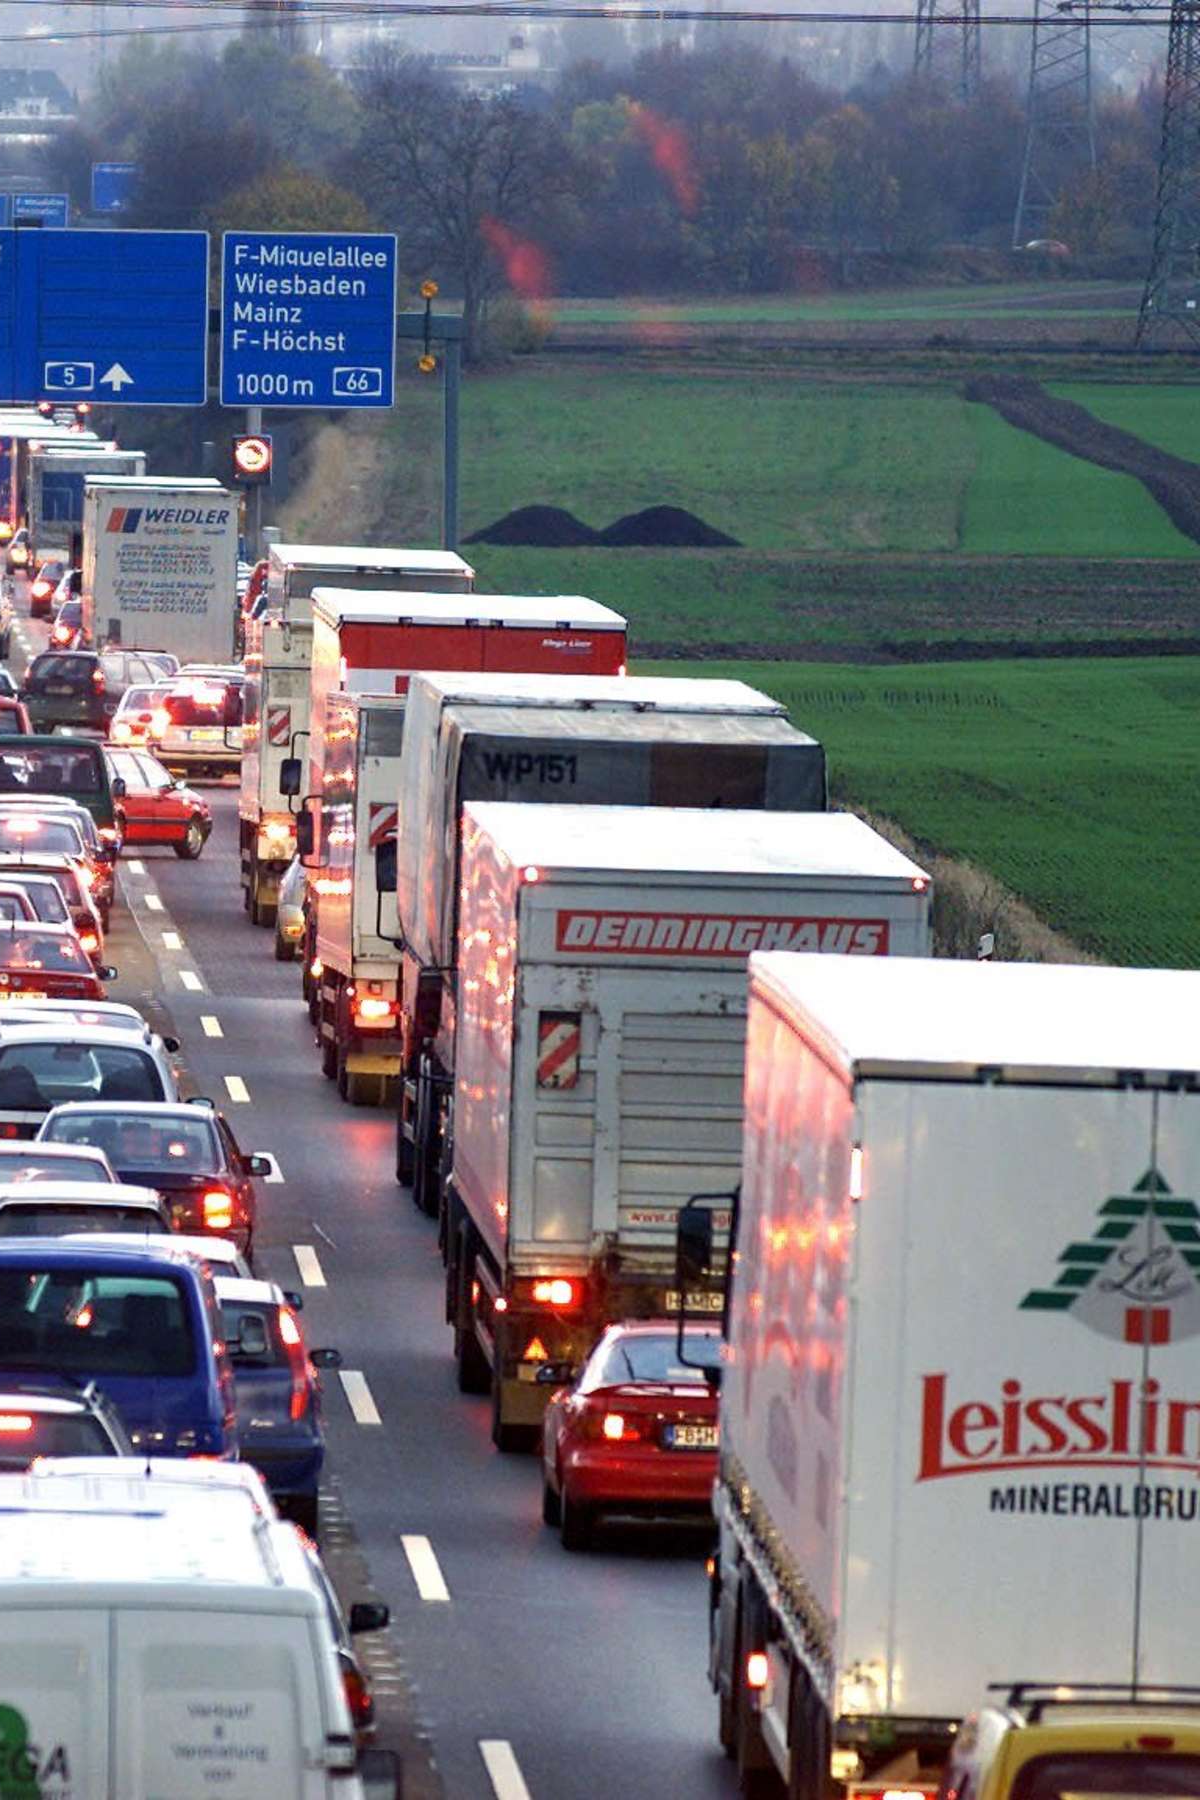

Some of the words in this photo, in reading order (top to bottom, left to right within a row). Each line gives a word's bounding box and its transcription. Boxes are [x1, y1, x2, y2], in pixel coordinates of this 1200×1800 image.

[234, 245, 388, 268] F-Miquelallee
[235, 274, 366, 296] Wiesbaden
[234, 302, 302, 323] Mainz
[233, 330, 346, 351] F-Höchst
[63, 367, 75, 385] 5
[346, 373, 369, 391] 66
[144, 508, 230, 524] WEIDLER
[483, 753, 577, 784] WP151
[562, 915, 885, 955] DENNINGHAUS
